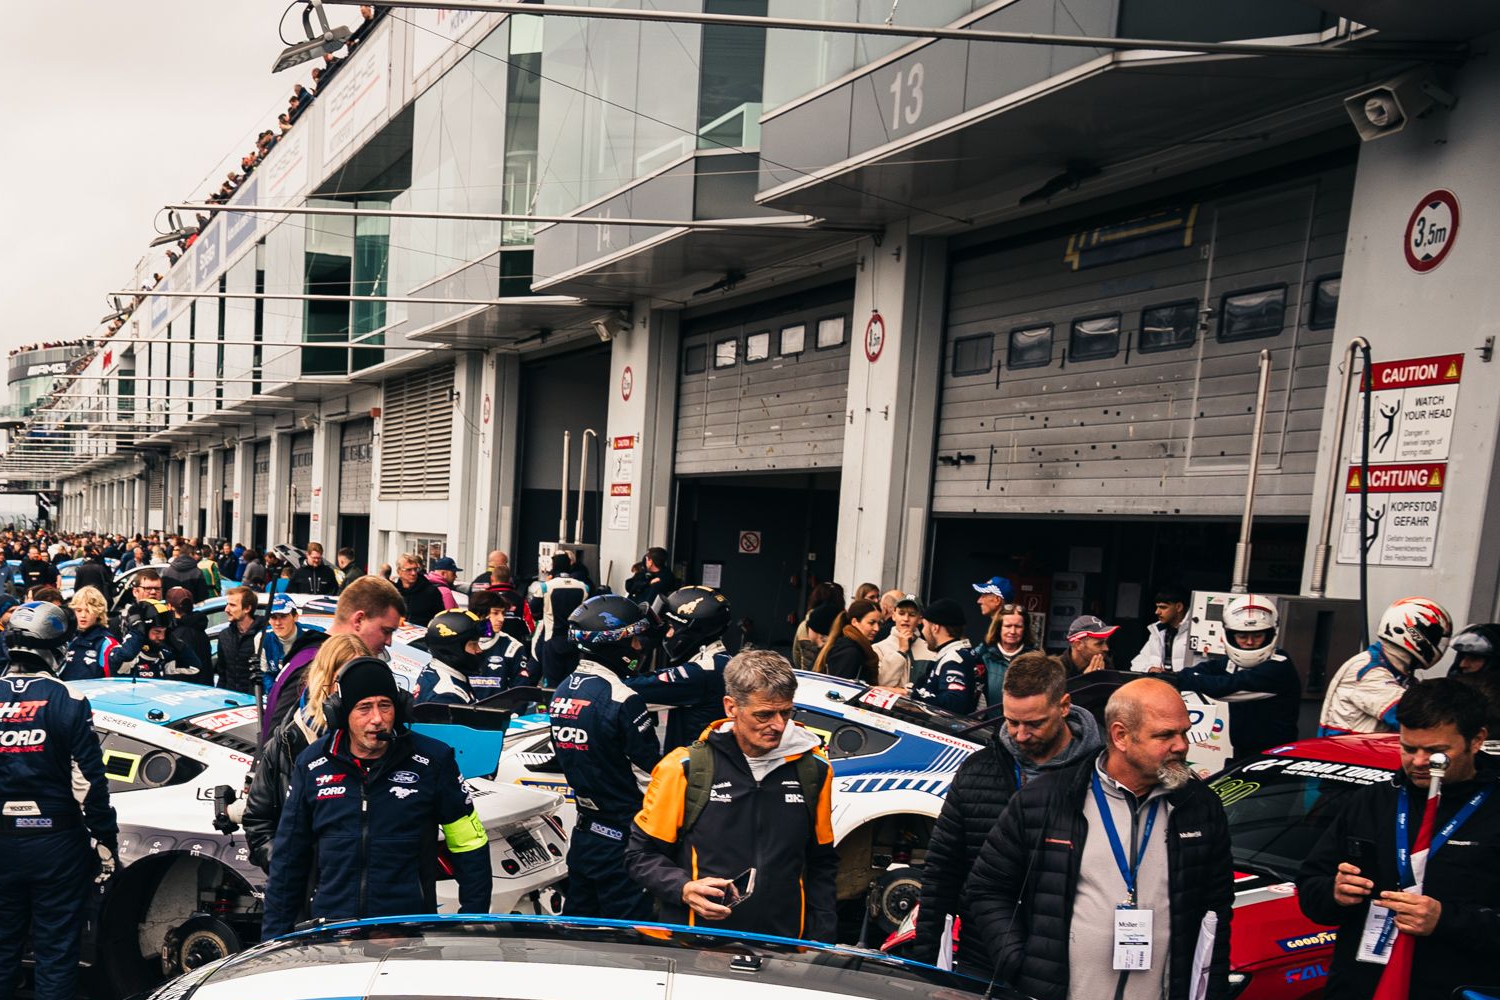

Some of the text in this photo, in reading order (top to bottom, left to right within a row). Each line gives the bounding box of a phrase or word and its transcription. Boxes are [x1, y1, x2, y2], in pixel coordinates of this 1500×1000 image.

[889, 62, 924, 130] 13
[27, 363, 68, 376] AMG
[1382, 364, 1438, 384] CAUTION
[1415, 395, 1445, 406] WATCH
[1404, 408, 1452, 420] YOUR HEAD
[1393, 516, 1430, 527] GEFAHR
[102, 715, 137, 729] SCHERER
[1286, 760, 1336, 775] GRAN
[317, 786, 347, 798] FORD
[15, 818, 52, 828] sparco
[590, 821, 623, 838] sparco
